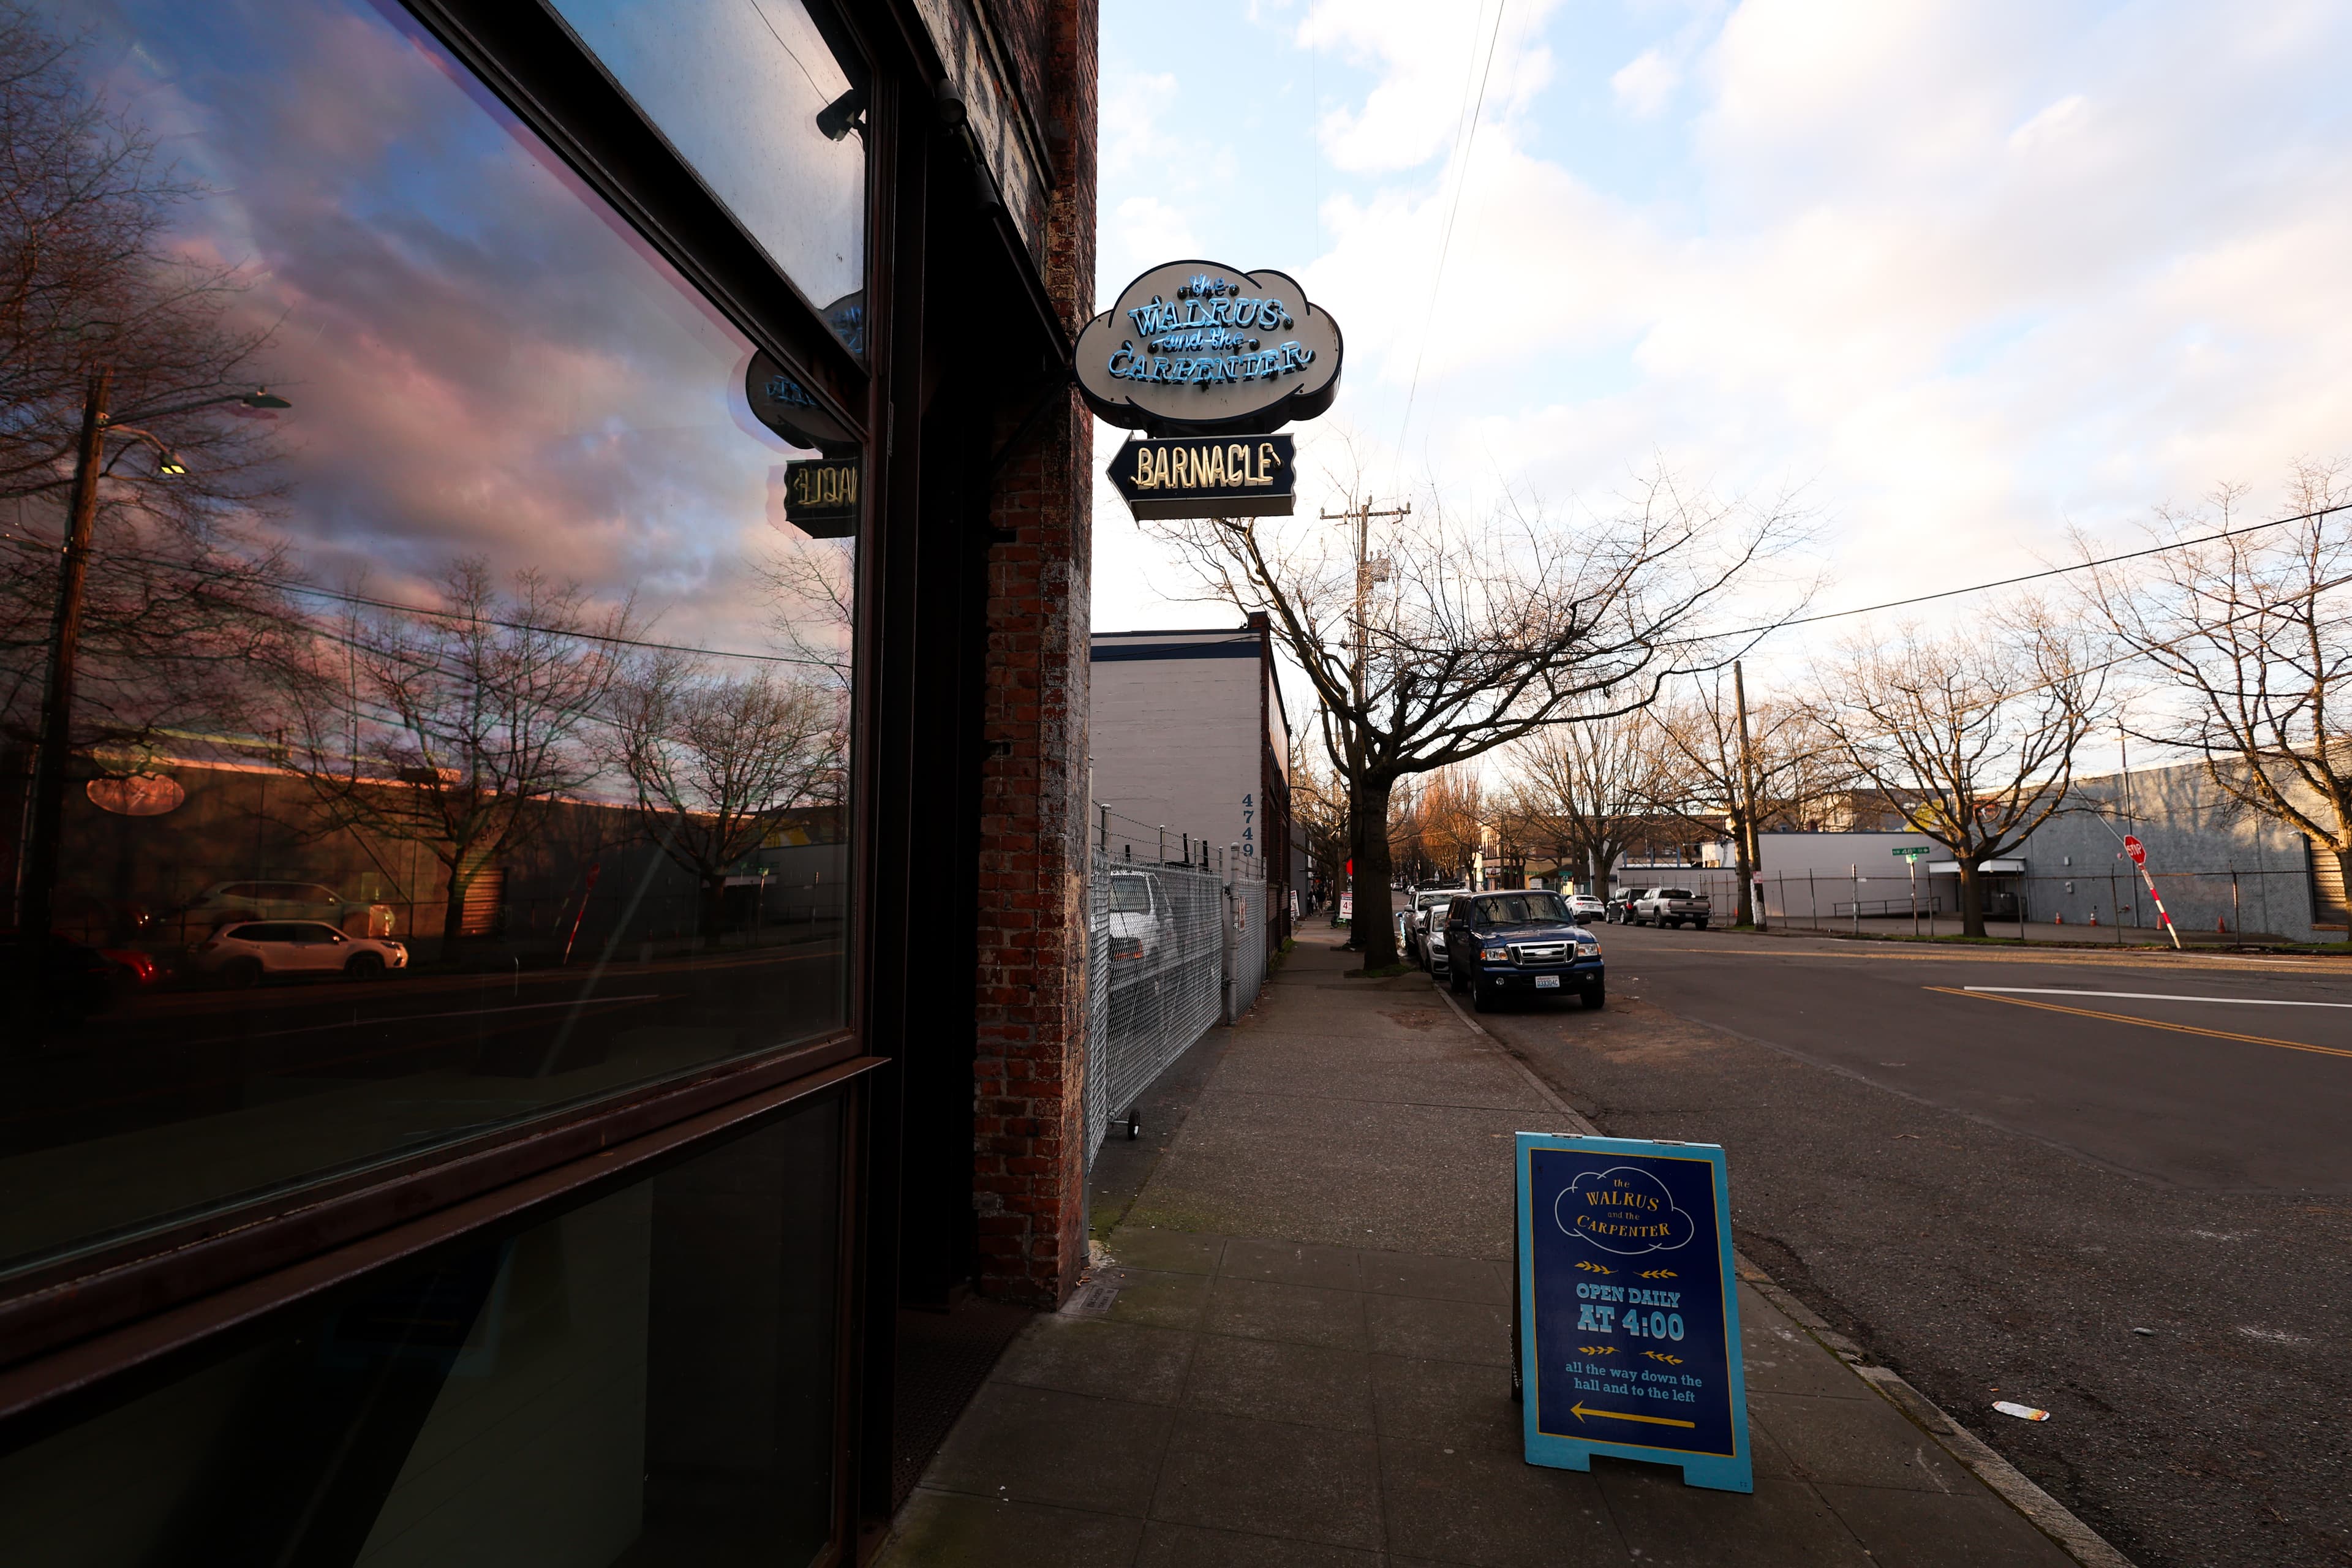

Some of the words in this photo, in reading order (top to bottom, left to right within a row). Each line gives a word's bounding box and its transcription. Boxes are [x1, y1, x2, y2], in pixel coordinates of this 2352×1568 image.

[1189, 273, 1227, 298] the
[1128, 298, 1286, 337] WALRUS
[1163, 331, 1203, 352] and
[1210, 328, 1245, 352] the
[1108, 341, 1311, 385] CARPENTER
[1137, 443, 1273, 490] BARNACLE
[1242, 793, 1254, 858] 4749
[2127, 843, 2141, 856] STOP
[1614, 1178, 1630, 1189] the
[1586, 1191, 1660, 1212] WALRUS
[1577, 1215, 1671, 1237] CARPENTER
[1607, 1211, 1623, 1219] and
[1625, 1212, 1640, 1221] the
[1576, 1283, 1624, 1303] OPEN
[1629, 1287, 1681, 1308] DAILY
[1577, 1304, 1615, 1333] AT
[1622, 1308, 1684, 1341] 4:00
[1566, 1362, 1582, 1374] all
[1586, 1363, 1606, 1376] the
[1610, 1368, 1637, 1382] way
[1641, 1370, 1678, 1385] down
[1681, 1374, 1703, 1387] the
[1574, 1378, 1600, 1392] hall
[1603, 1384, 1629, 1395] and
[1632, 1386, 1644, 1396] to
[1648, 1387, 1669, 1400] the
[1672, 1389, 1695, 1403] left
